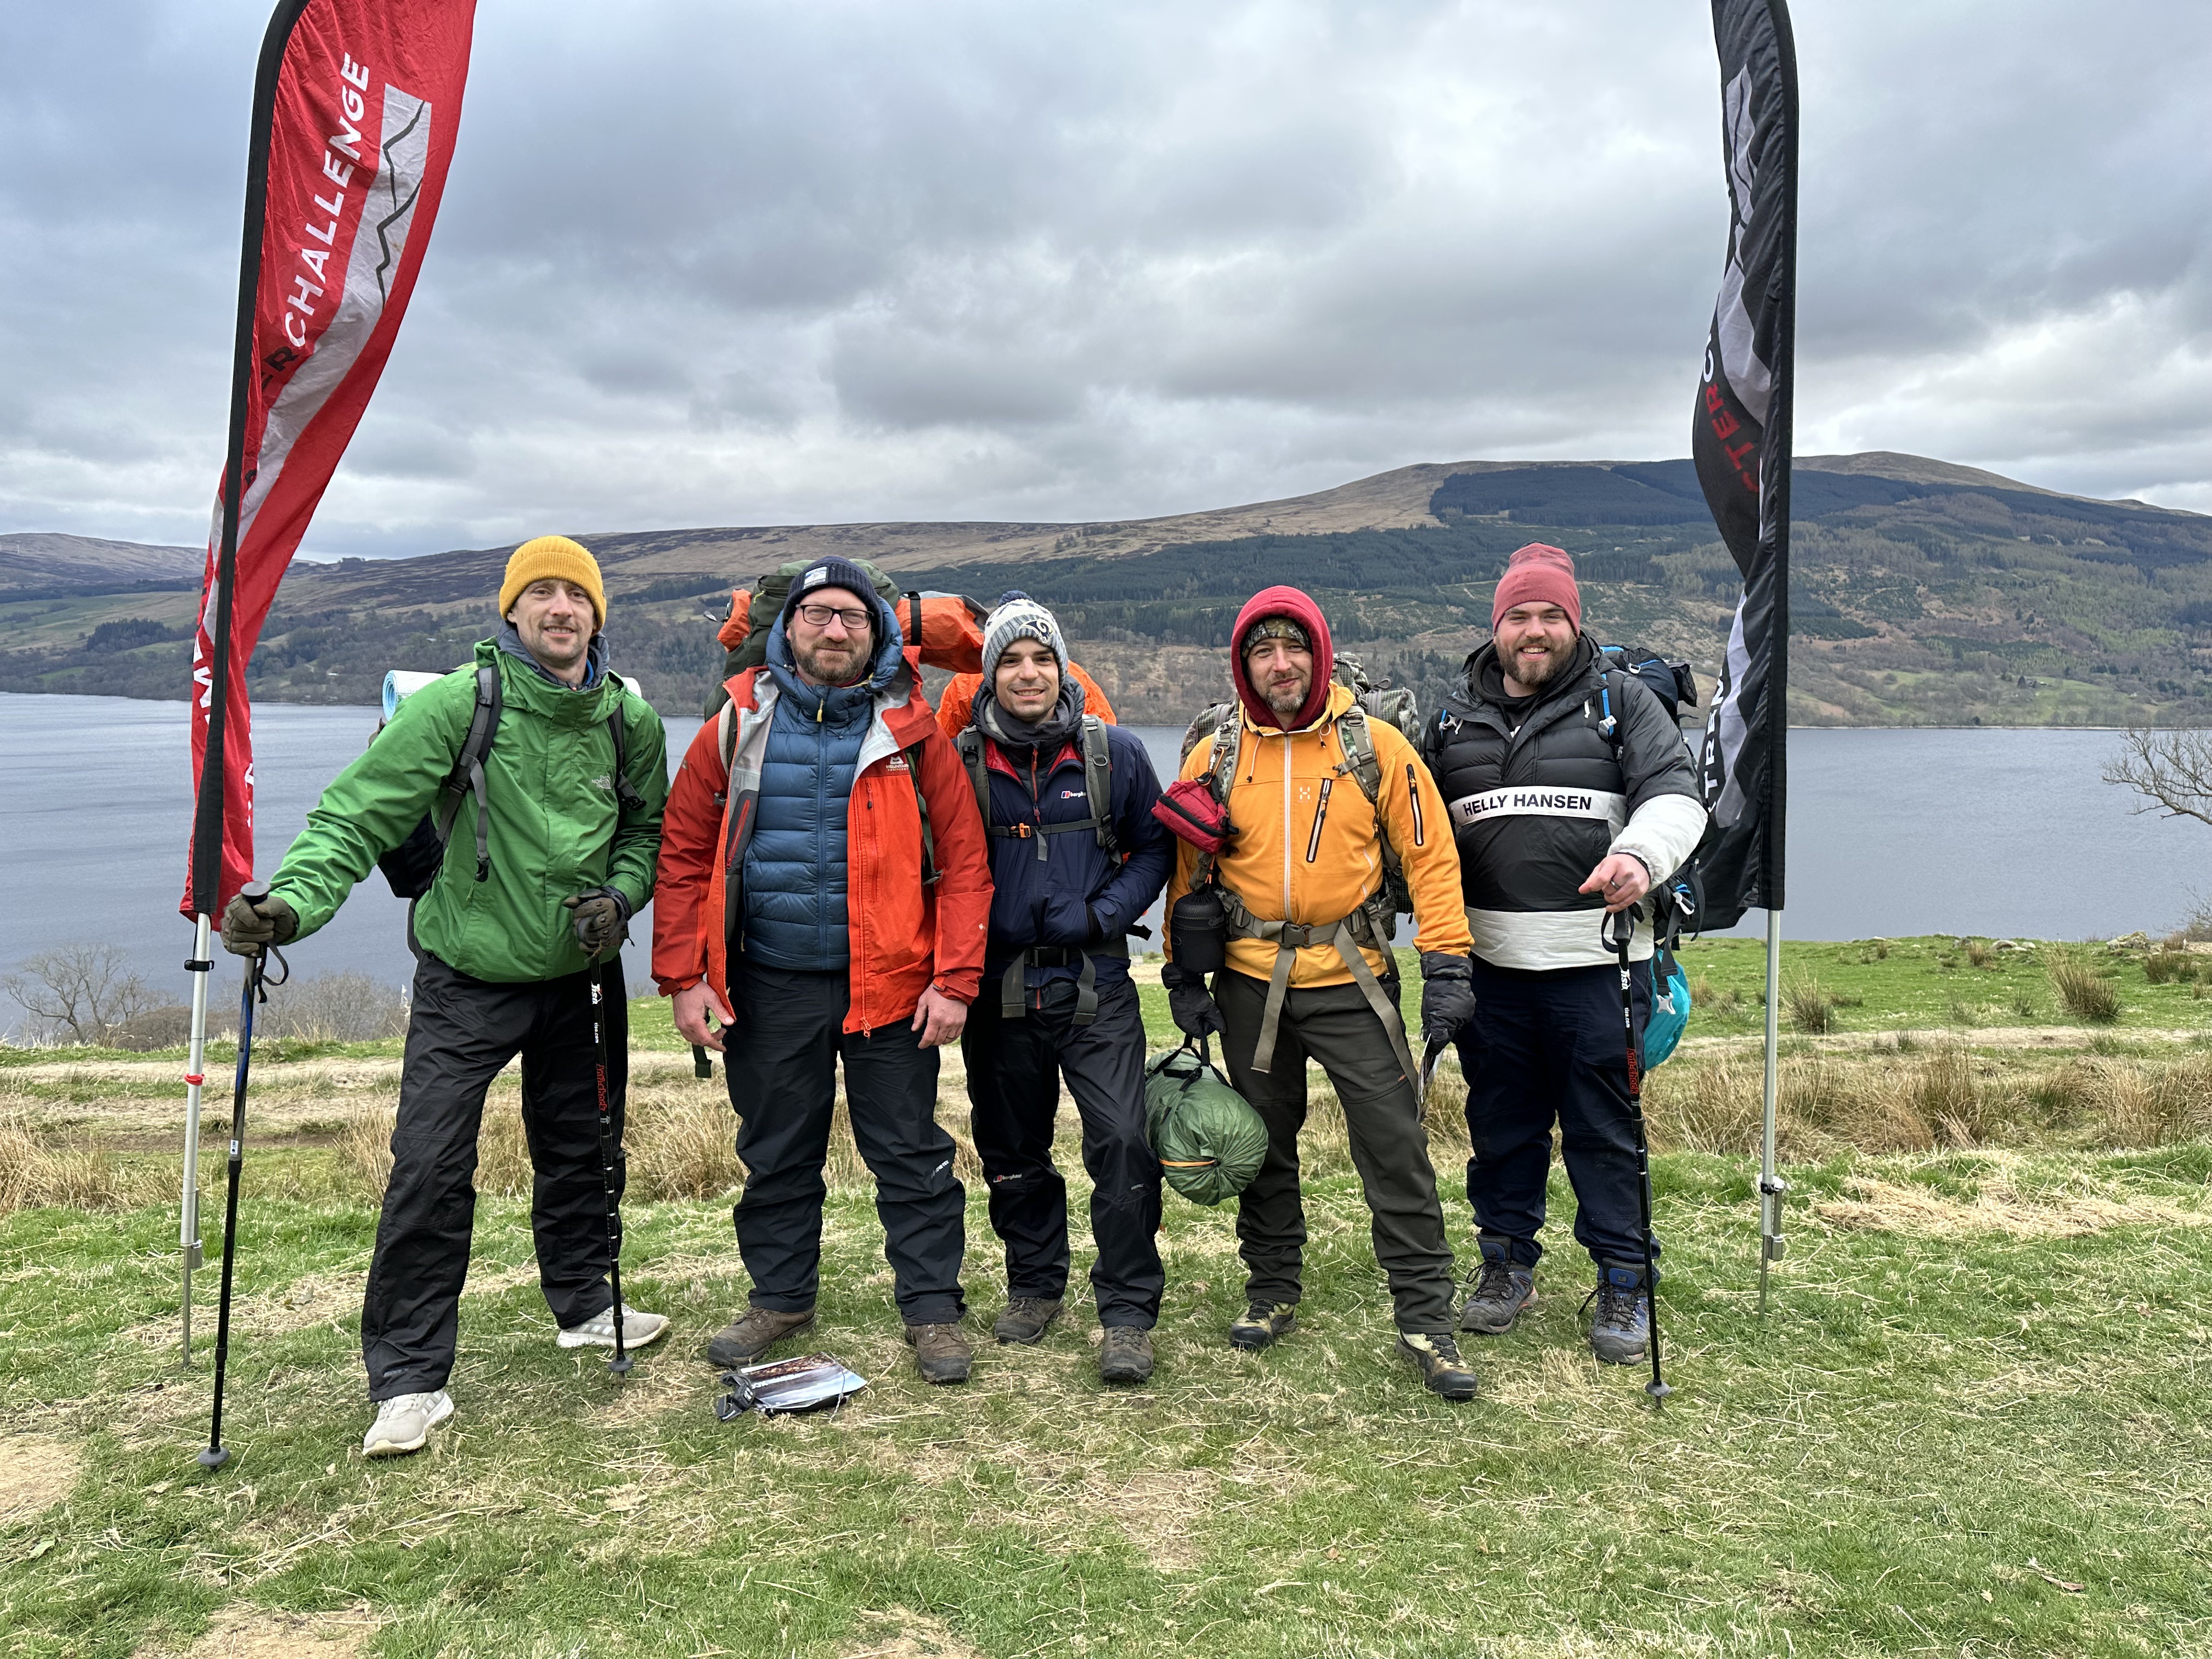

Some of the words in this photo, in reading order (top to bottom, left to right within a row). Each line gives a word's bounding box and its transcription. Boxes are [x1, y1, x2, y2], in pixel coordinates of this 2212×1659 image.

[285, 52, 370, 348] CHALLENGE
[1462, 794, 1509, 817] HELLY
[1513, 793, 1592, 810] HANSEN
[1626, 1046, 1640, 1094] Anti-shock
